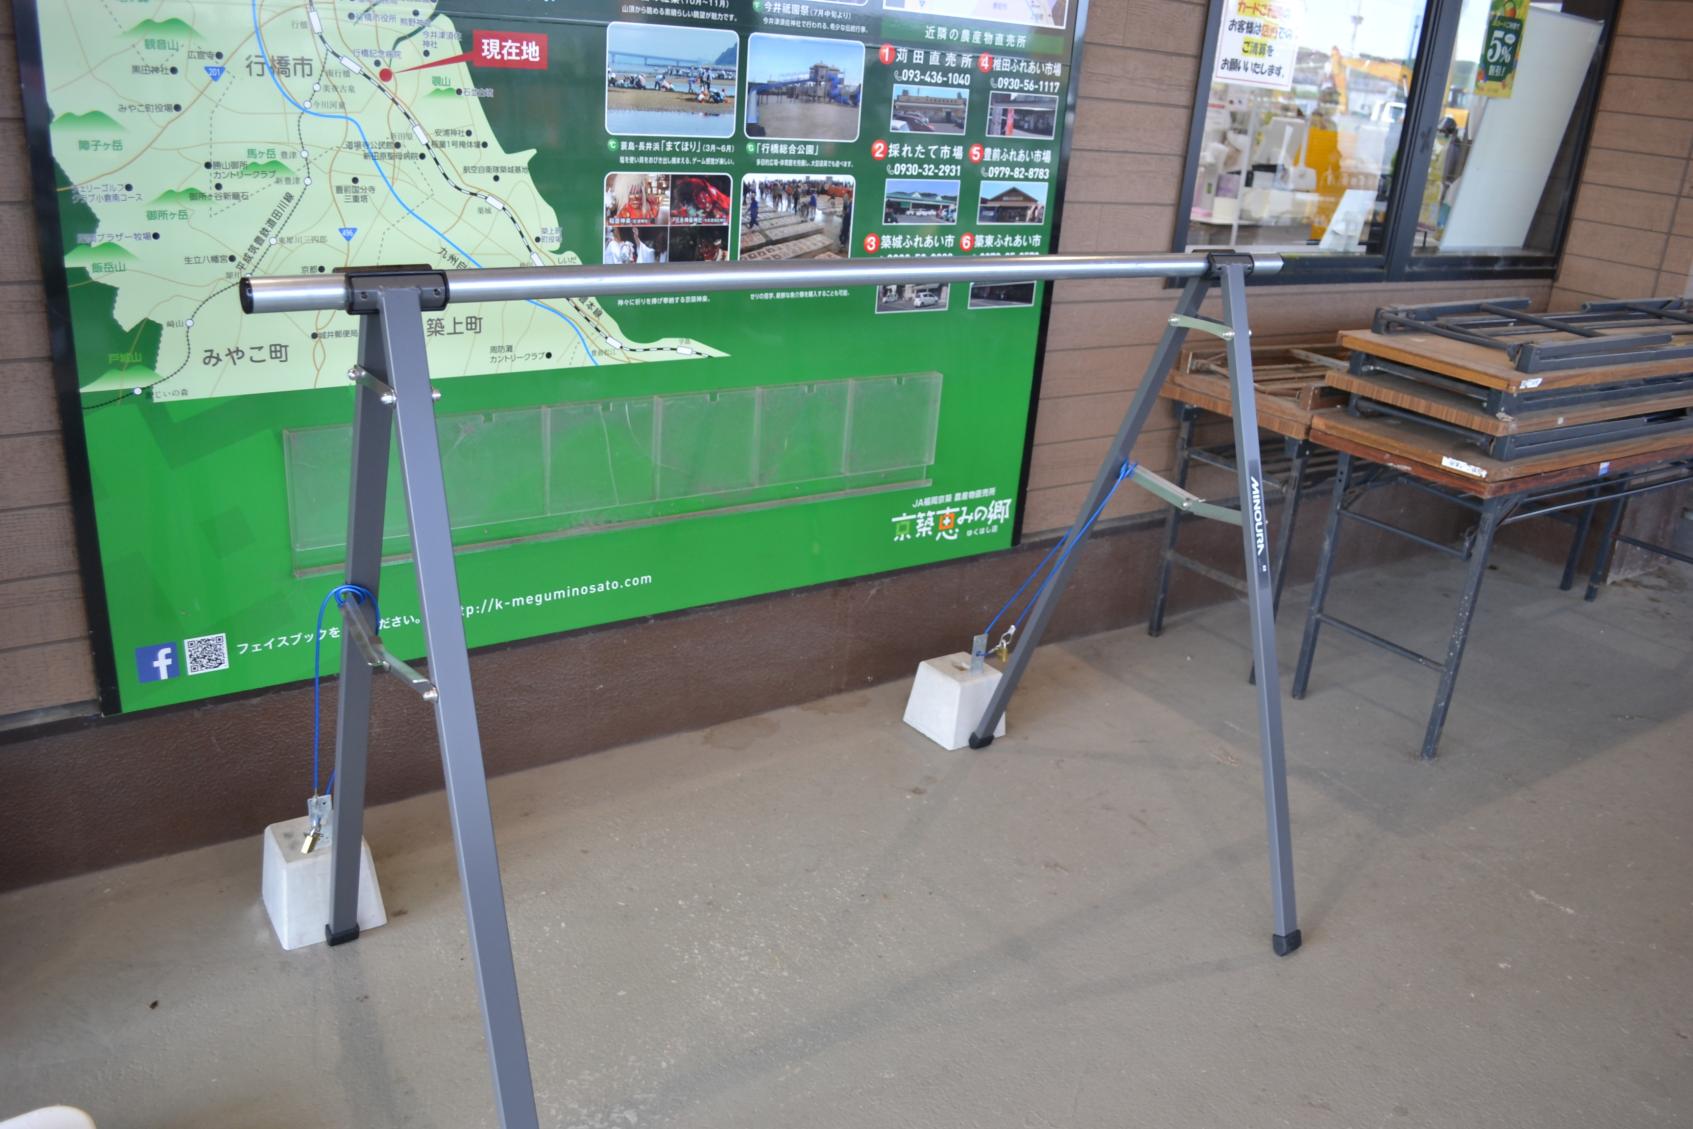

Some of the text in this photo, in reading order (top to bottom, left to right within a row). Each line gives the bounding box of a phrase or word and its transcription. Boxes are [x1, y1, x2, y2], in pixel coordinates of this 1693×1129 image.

[924, 25, 1028, 48] 近隣の農産物直売所
[481, 38, 541, 63] 現在地
[896, 48, 974, 69] 苅田直売所
[245, 54, 314, 79] 行橋市
[1220, 57, 1285, 78] お願いいたします。
[902, 69, 971, 86] 093-436-1040
[997, 77, 1060, 94] 0930-56-1117
[888, 143, 965, 161] 採れたて市場
[983, 147, 1052, 165] 豊前ふれあい市場
[894, 163, 961, 177] 0930-32-2931
[988, 166, 1050, 180] 0979-82-8783
[881, 234, 956, 250] 築城ふれあい市
[974, 233, 1042, 249] 築東ふれあい市
[426, 316, 484, 338] 築上町
[202, 344, 290, 368] みやこ町
[489, 352, 545, 364] カントリークラブ
[891, 498, 1012, 542] 京築恵みの郷
[1250, 475, 1265, 556] MINOURA
